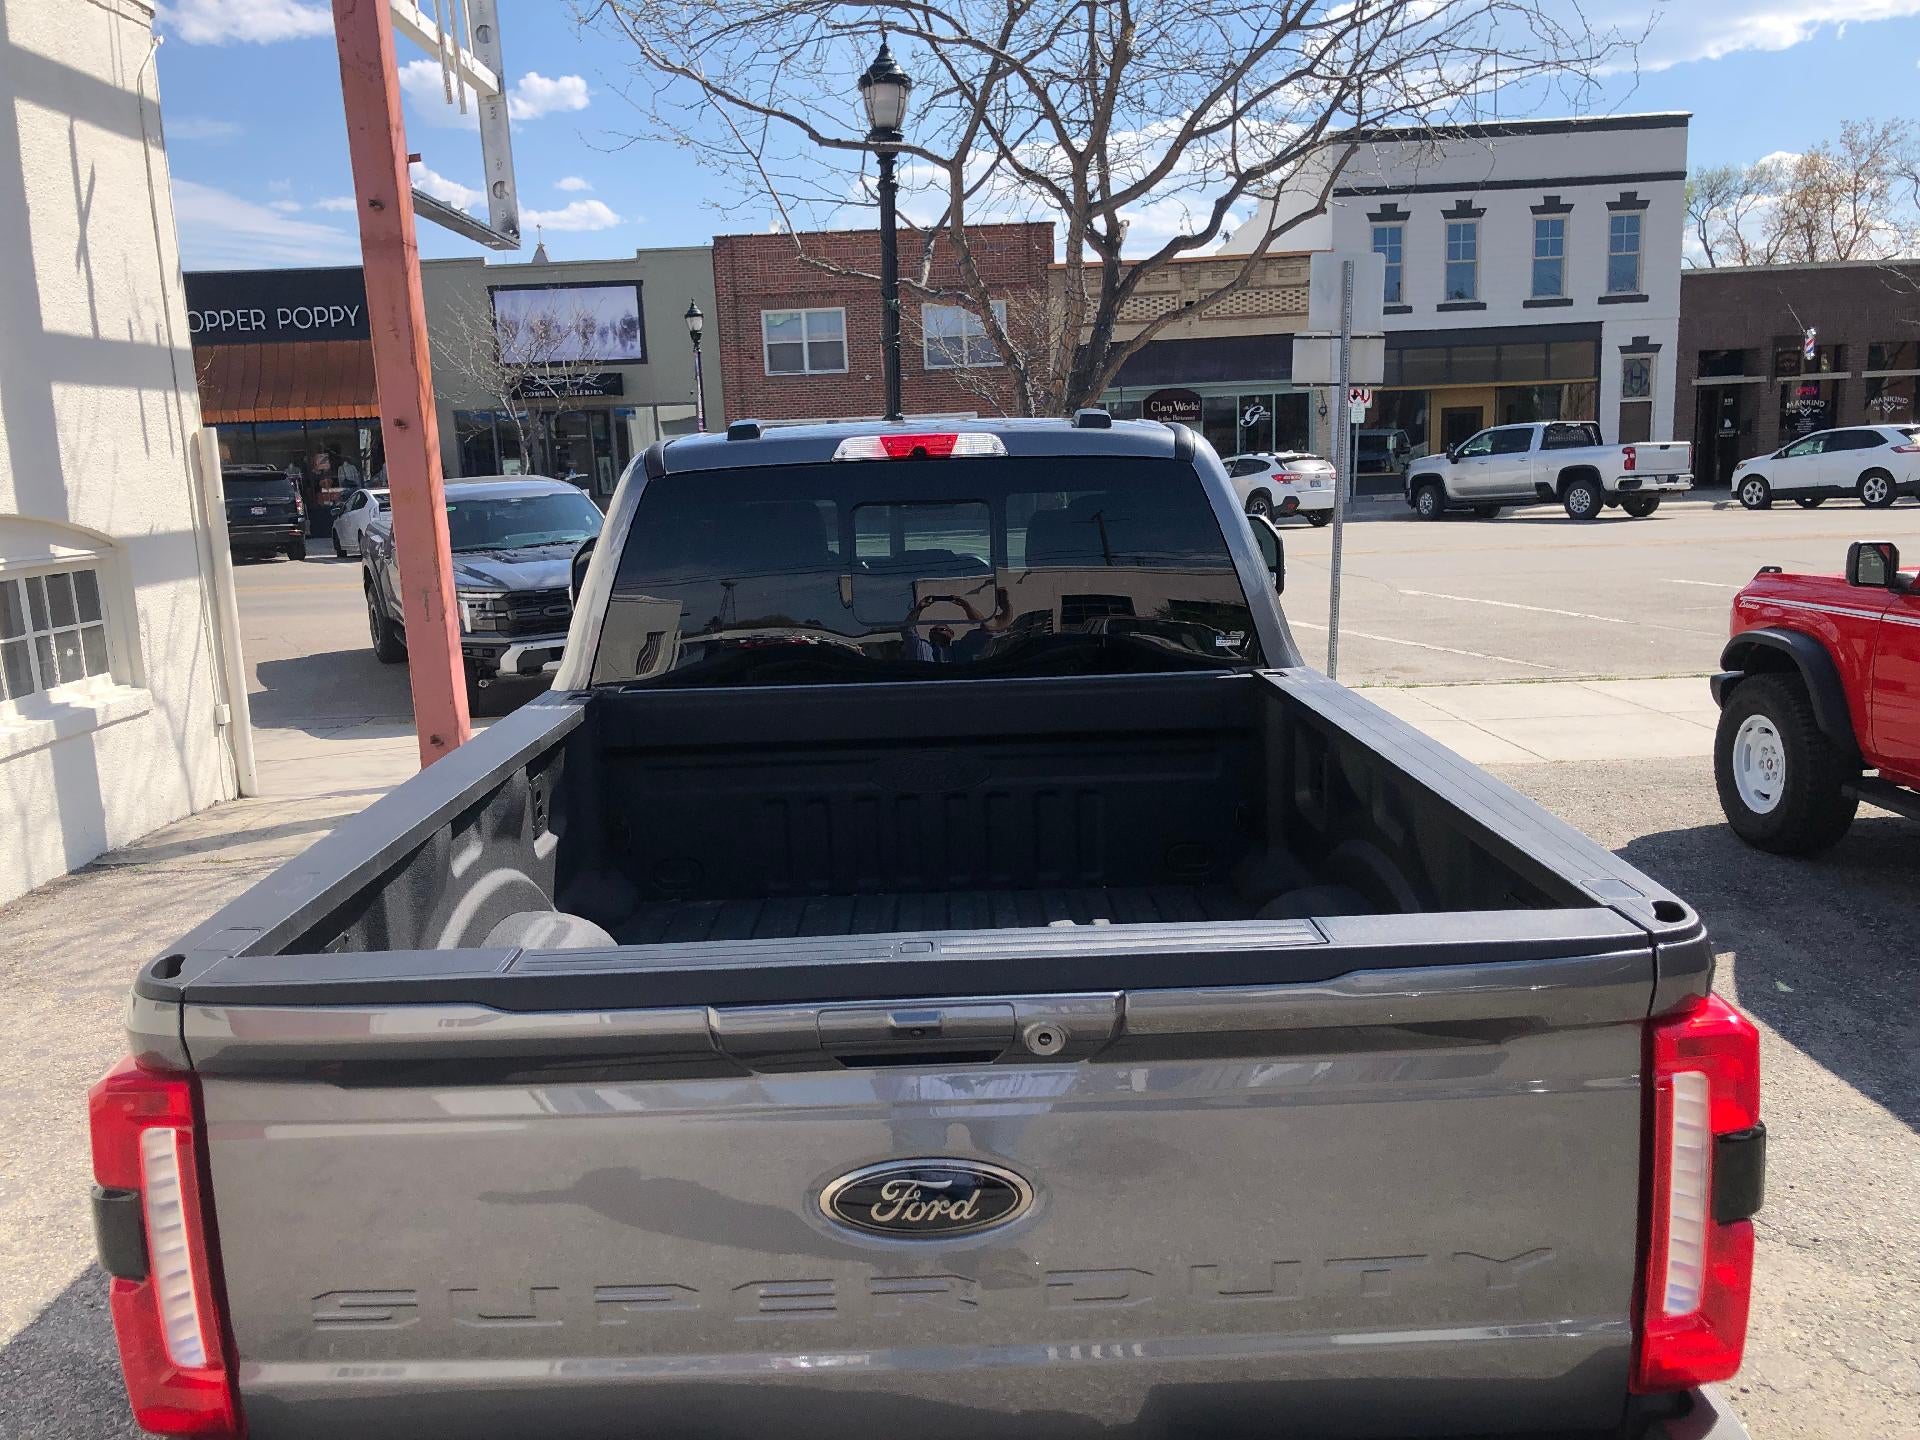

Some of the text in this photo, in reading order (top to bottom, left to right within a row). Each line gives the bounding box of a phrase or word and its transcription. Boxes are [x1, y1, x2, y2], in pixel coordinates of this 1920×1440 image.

[277, 305, 359, 329] POPPY
[523, 390, 557, 398] CORWI
[1870, 395, 1909, 406] MANKIND
[1150, 401, 1173, 414] Clay
[1786, 400, 1826, 409] MANKIND
[870, 1179, 981, 1223] Ford
[310, 1247, 1554, 1329] SUPER DUTY
